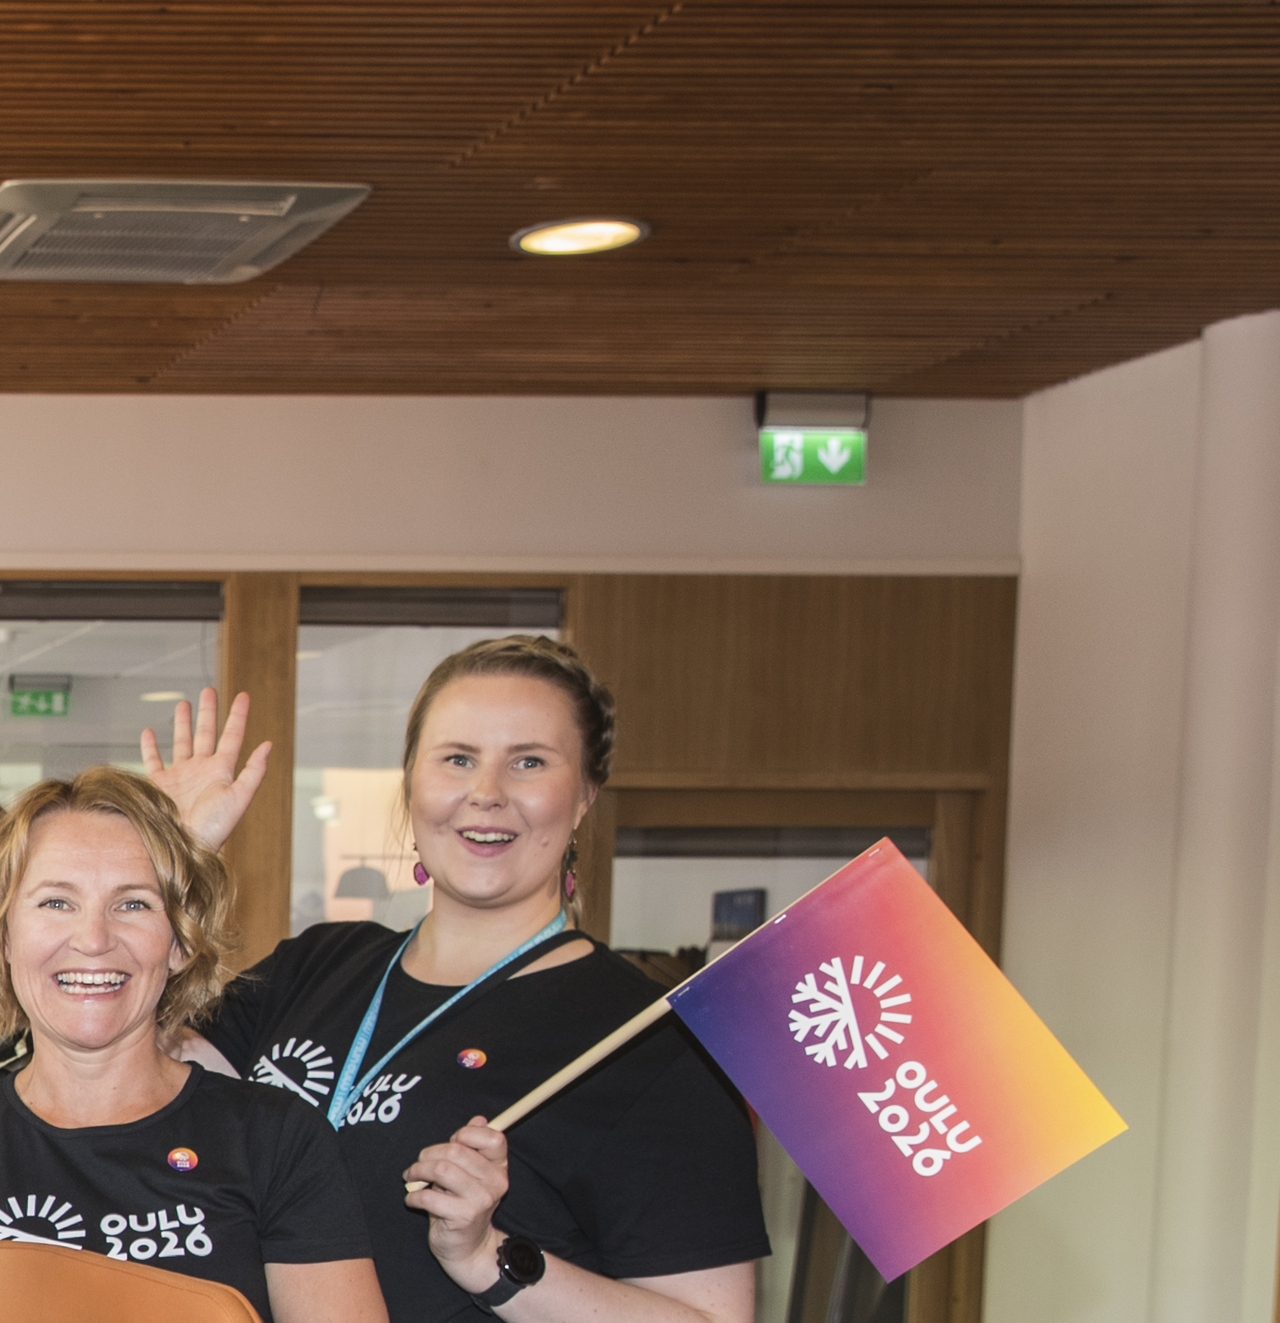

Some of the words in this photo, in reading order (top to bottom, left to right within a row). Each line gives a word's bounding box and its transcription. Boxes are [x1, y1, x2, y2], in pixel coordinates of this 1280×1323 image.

[350, 1073, 422, 1102] ULU
[338, 1093, 402, 1127] 026
[895, 1060, 983, 1154] OULU
[856, 1078, 952, 1177] 2026
[100, 1204, 205, 1236] OULU
[106, 1224, 213, 1261] 2026
